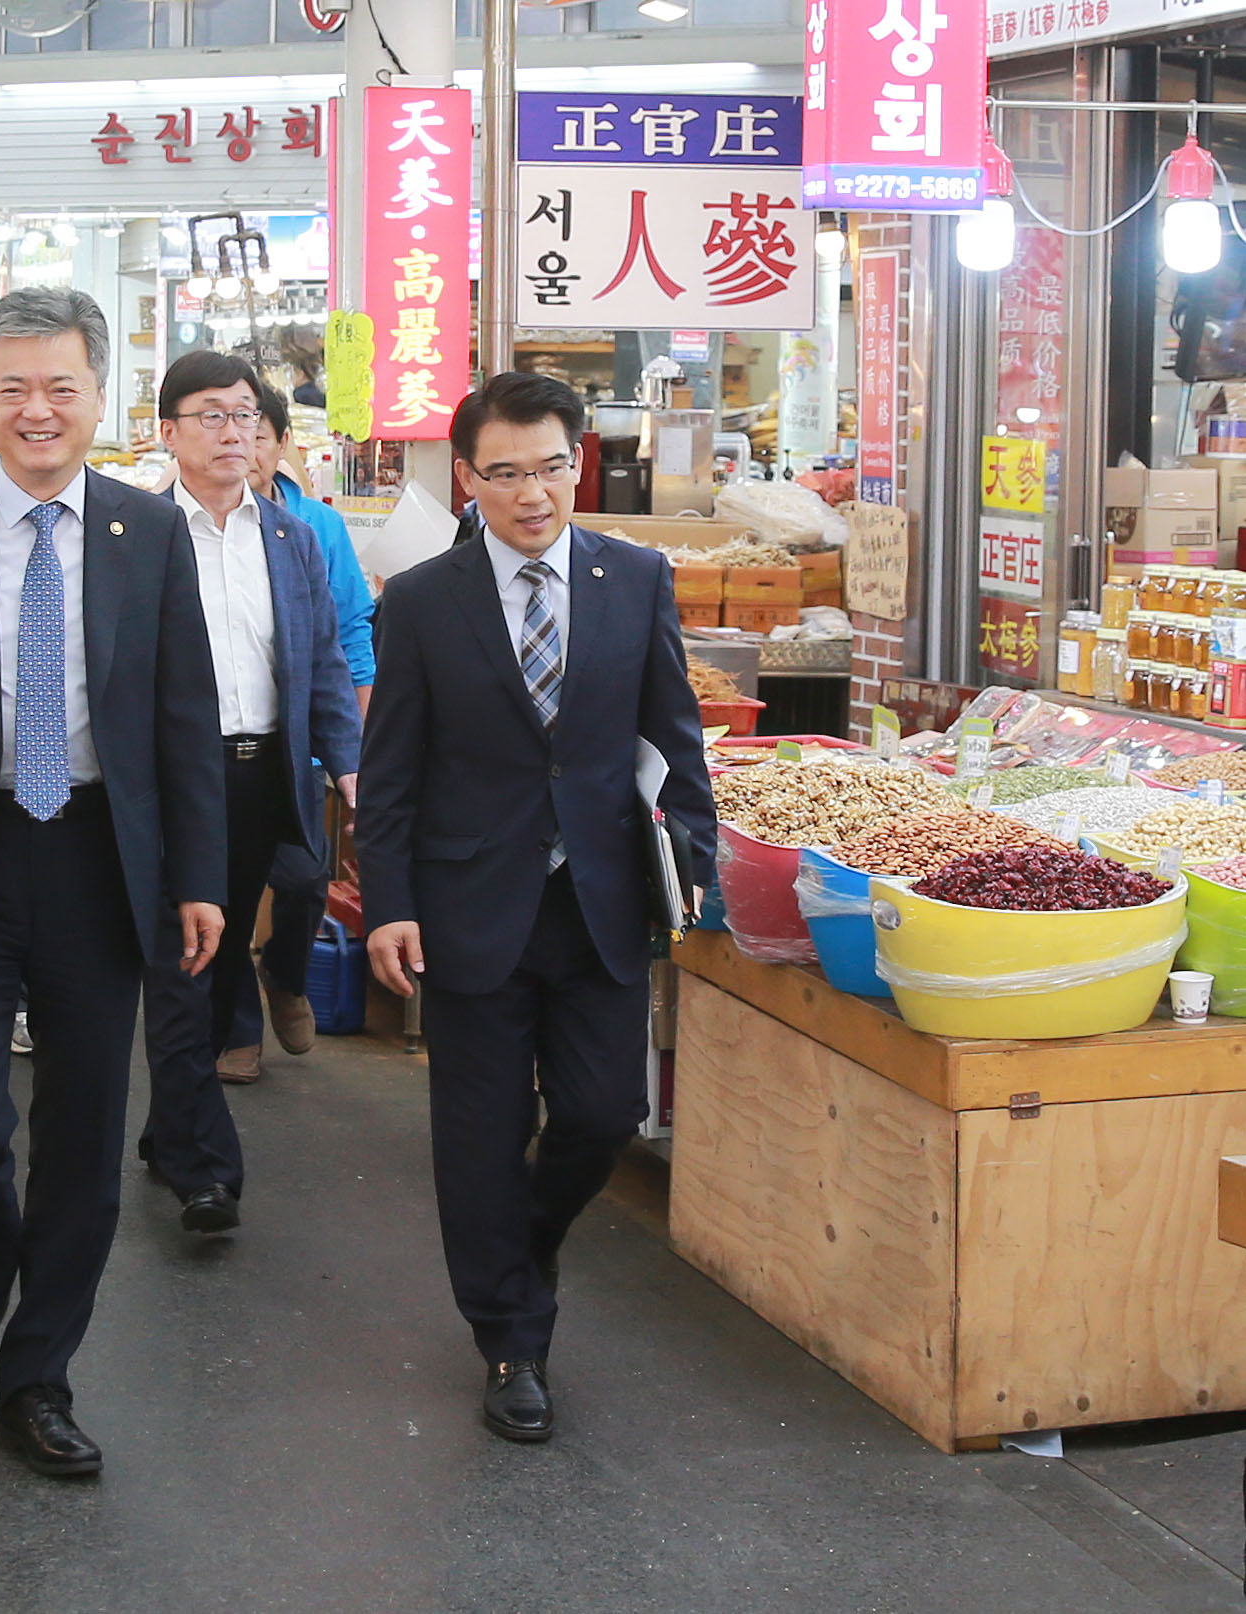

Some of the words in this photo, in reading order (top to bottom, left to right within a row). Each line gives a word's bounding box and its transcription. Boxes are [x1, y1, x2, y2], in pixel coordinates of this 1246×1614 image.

[867, 0, 949, 157] 상회
[91, 104, 324, 165] 순진상회
[552, 101, 781, 158] 正官庄
[854, 174, 977, 200] 2273-5869
[525, 188, 582, 307] 서울
[591, 189, 800, 308] 人蔘
[1032, 273, 1062, 399] 最低价格
[980, 531, 1042, 586] 正官庄
